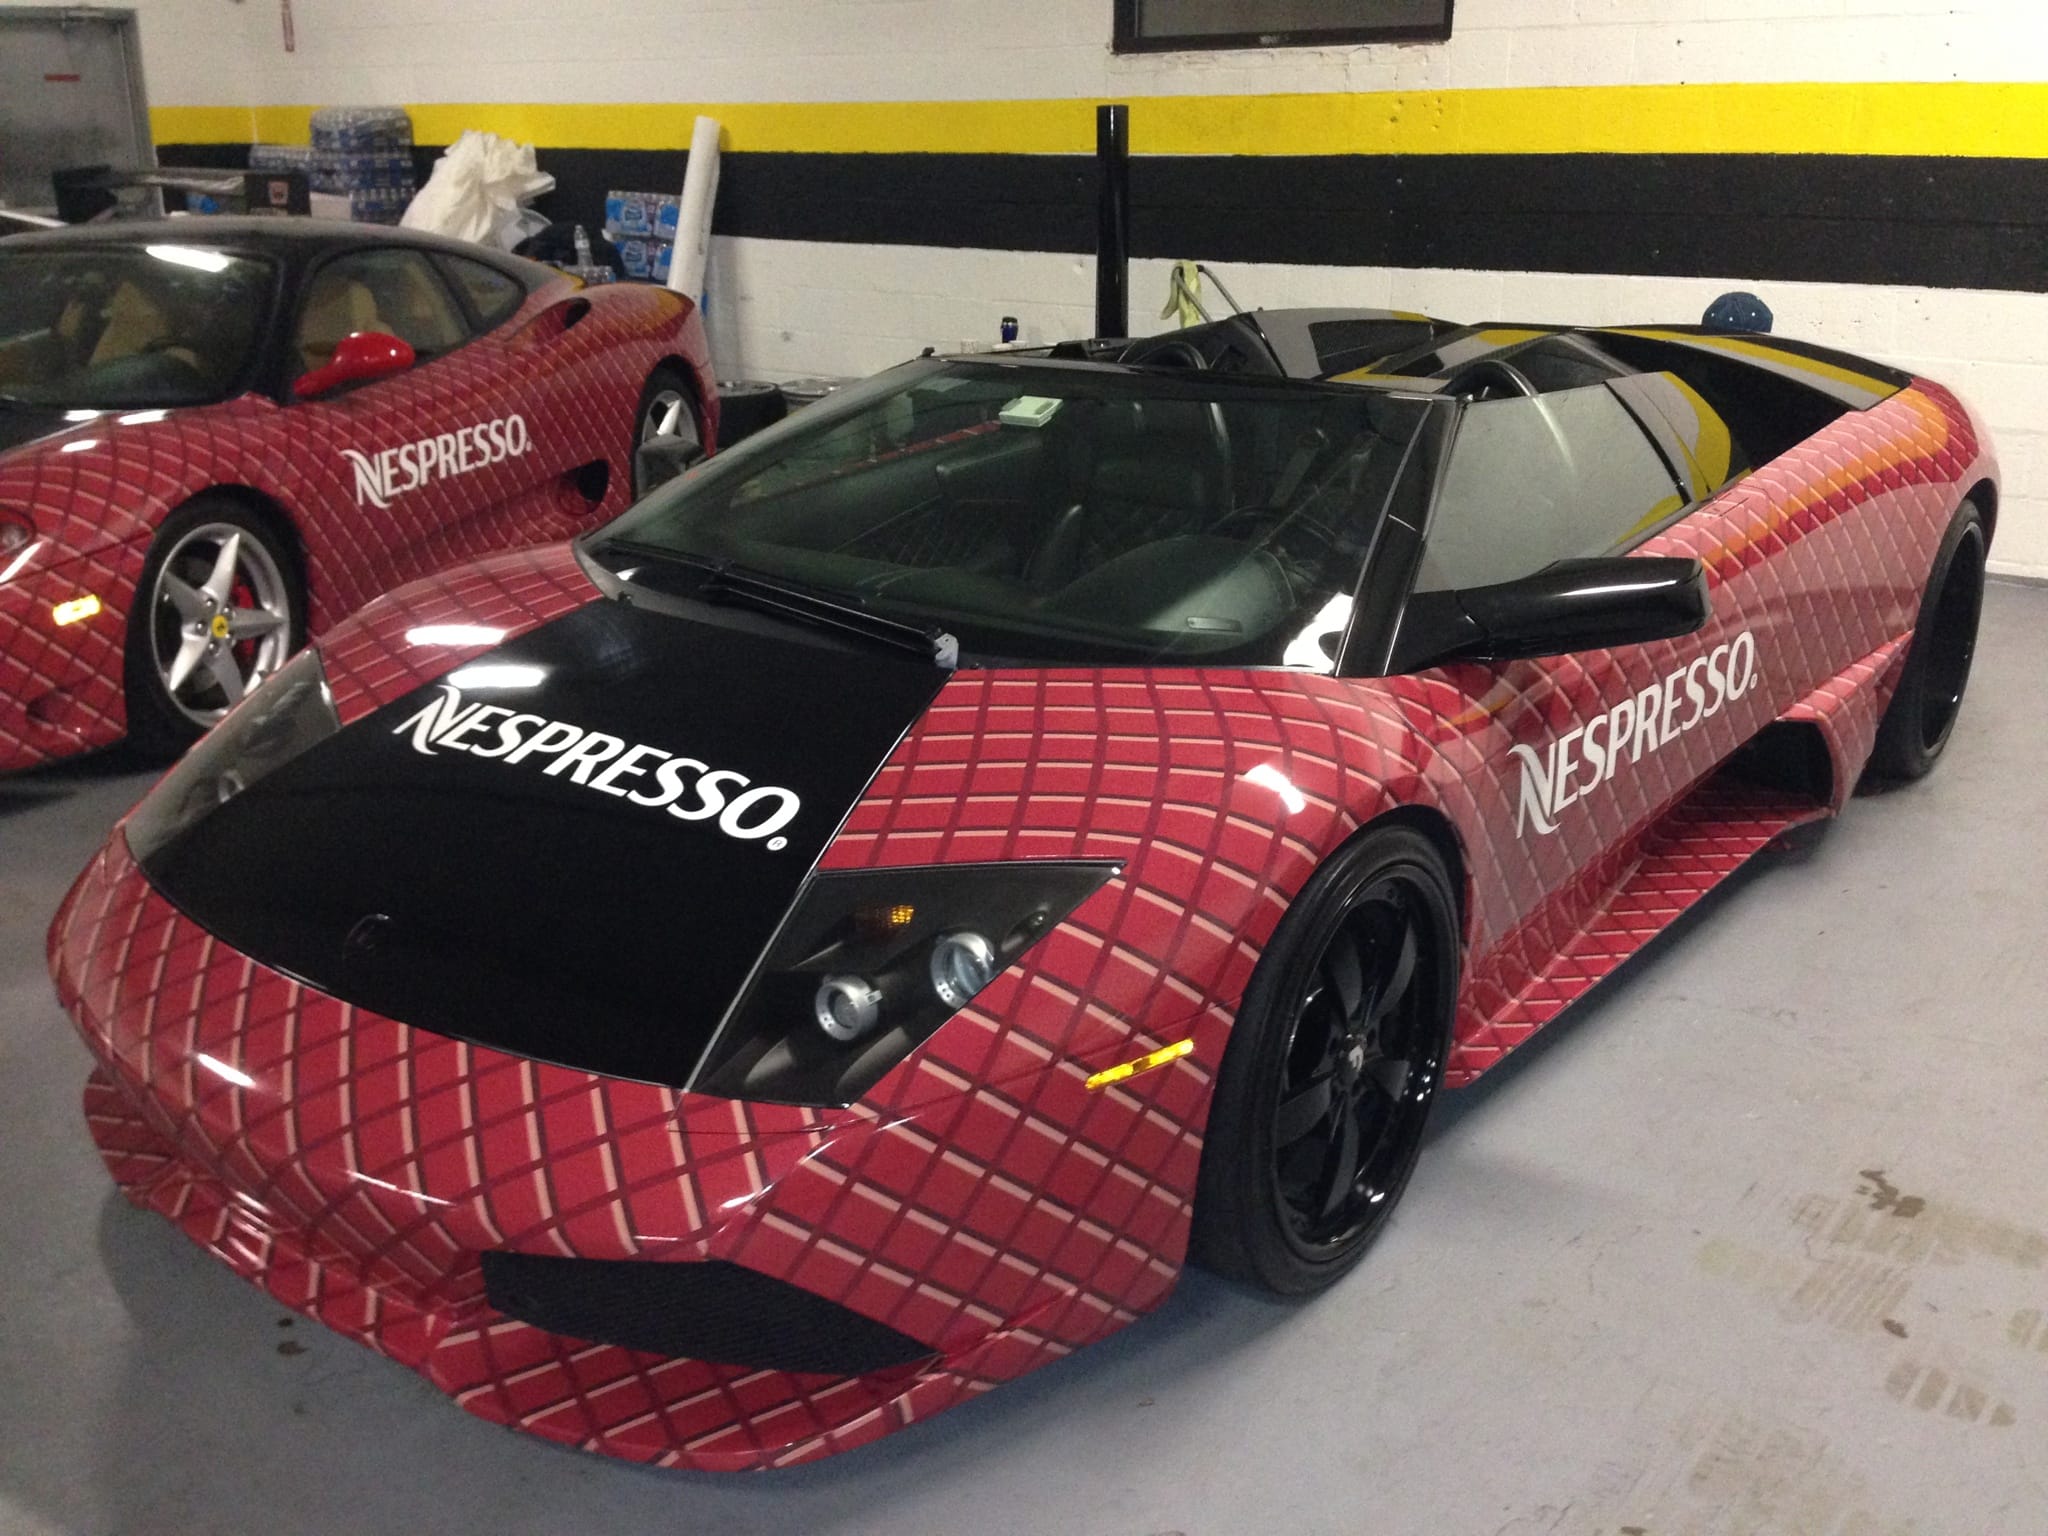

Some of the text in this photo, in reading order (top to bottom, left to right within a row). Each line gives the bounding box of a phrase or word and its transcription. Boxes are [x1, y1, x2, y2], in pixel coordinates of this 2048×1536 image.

[339, 414, 532, 509] NESPRESSO
[392, 684, 801, 851] NESPRESSO
[1506, 631, 1757, 839] NESPRESSO
